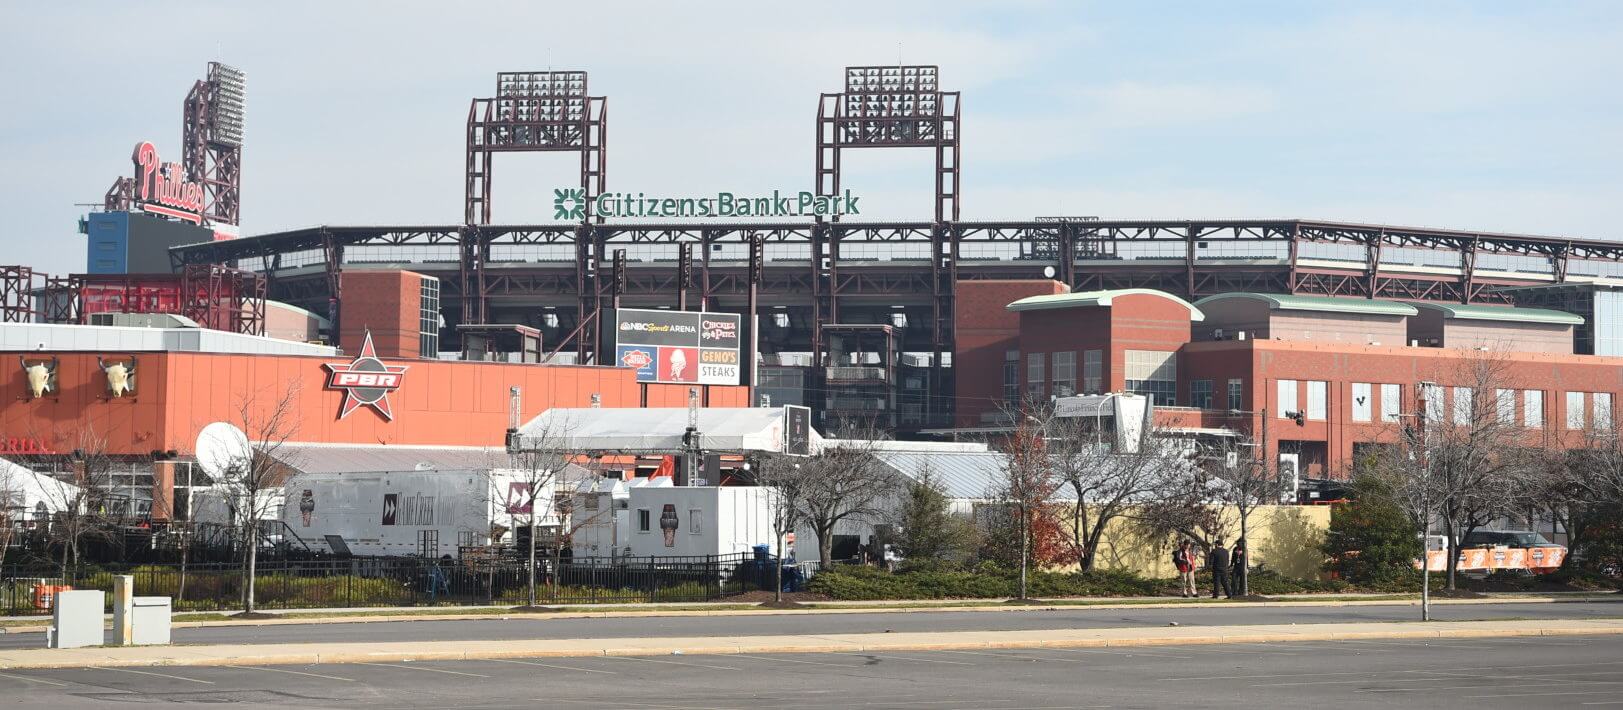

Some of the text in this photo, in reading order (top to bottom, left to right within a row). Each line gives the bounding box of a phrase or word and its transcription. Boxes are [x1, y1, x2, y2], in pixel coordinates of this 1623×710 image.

[138, 141, 204, 212] Phillies
[597, 189, 860, 217] Citizens Bank Park
[630, 322, 648, 332] NBC
[669, 324, 697, 333] ARENA
[702, 351, 736, 363] GENO'S
[702, 366, 736, 378] STEAKS
[339, 373, 397, 387] PBR
